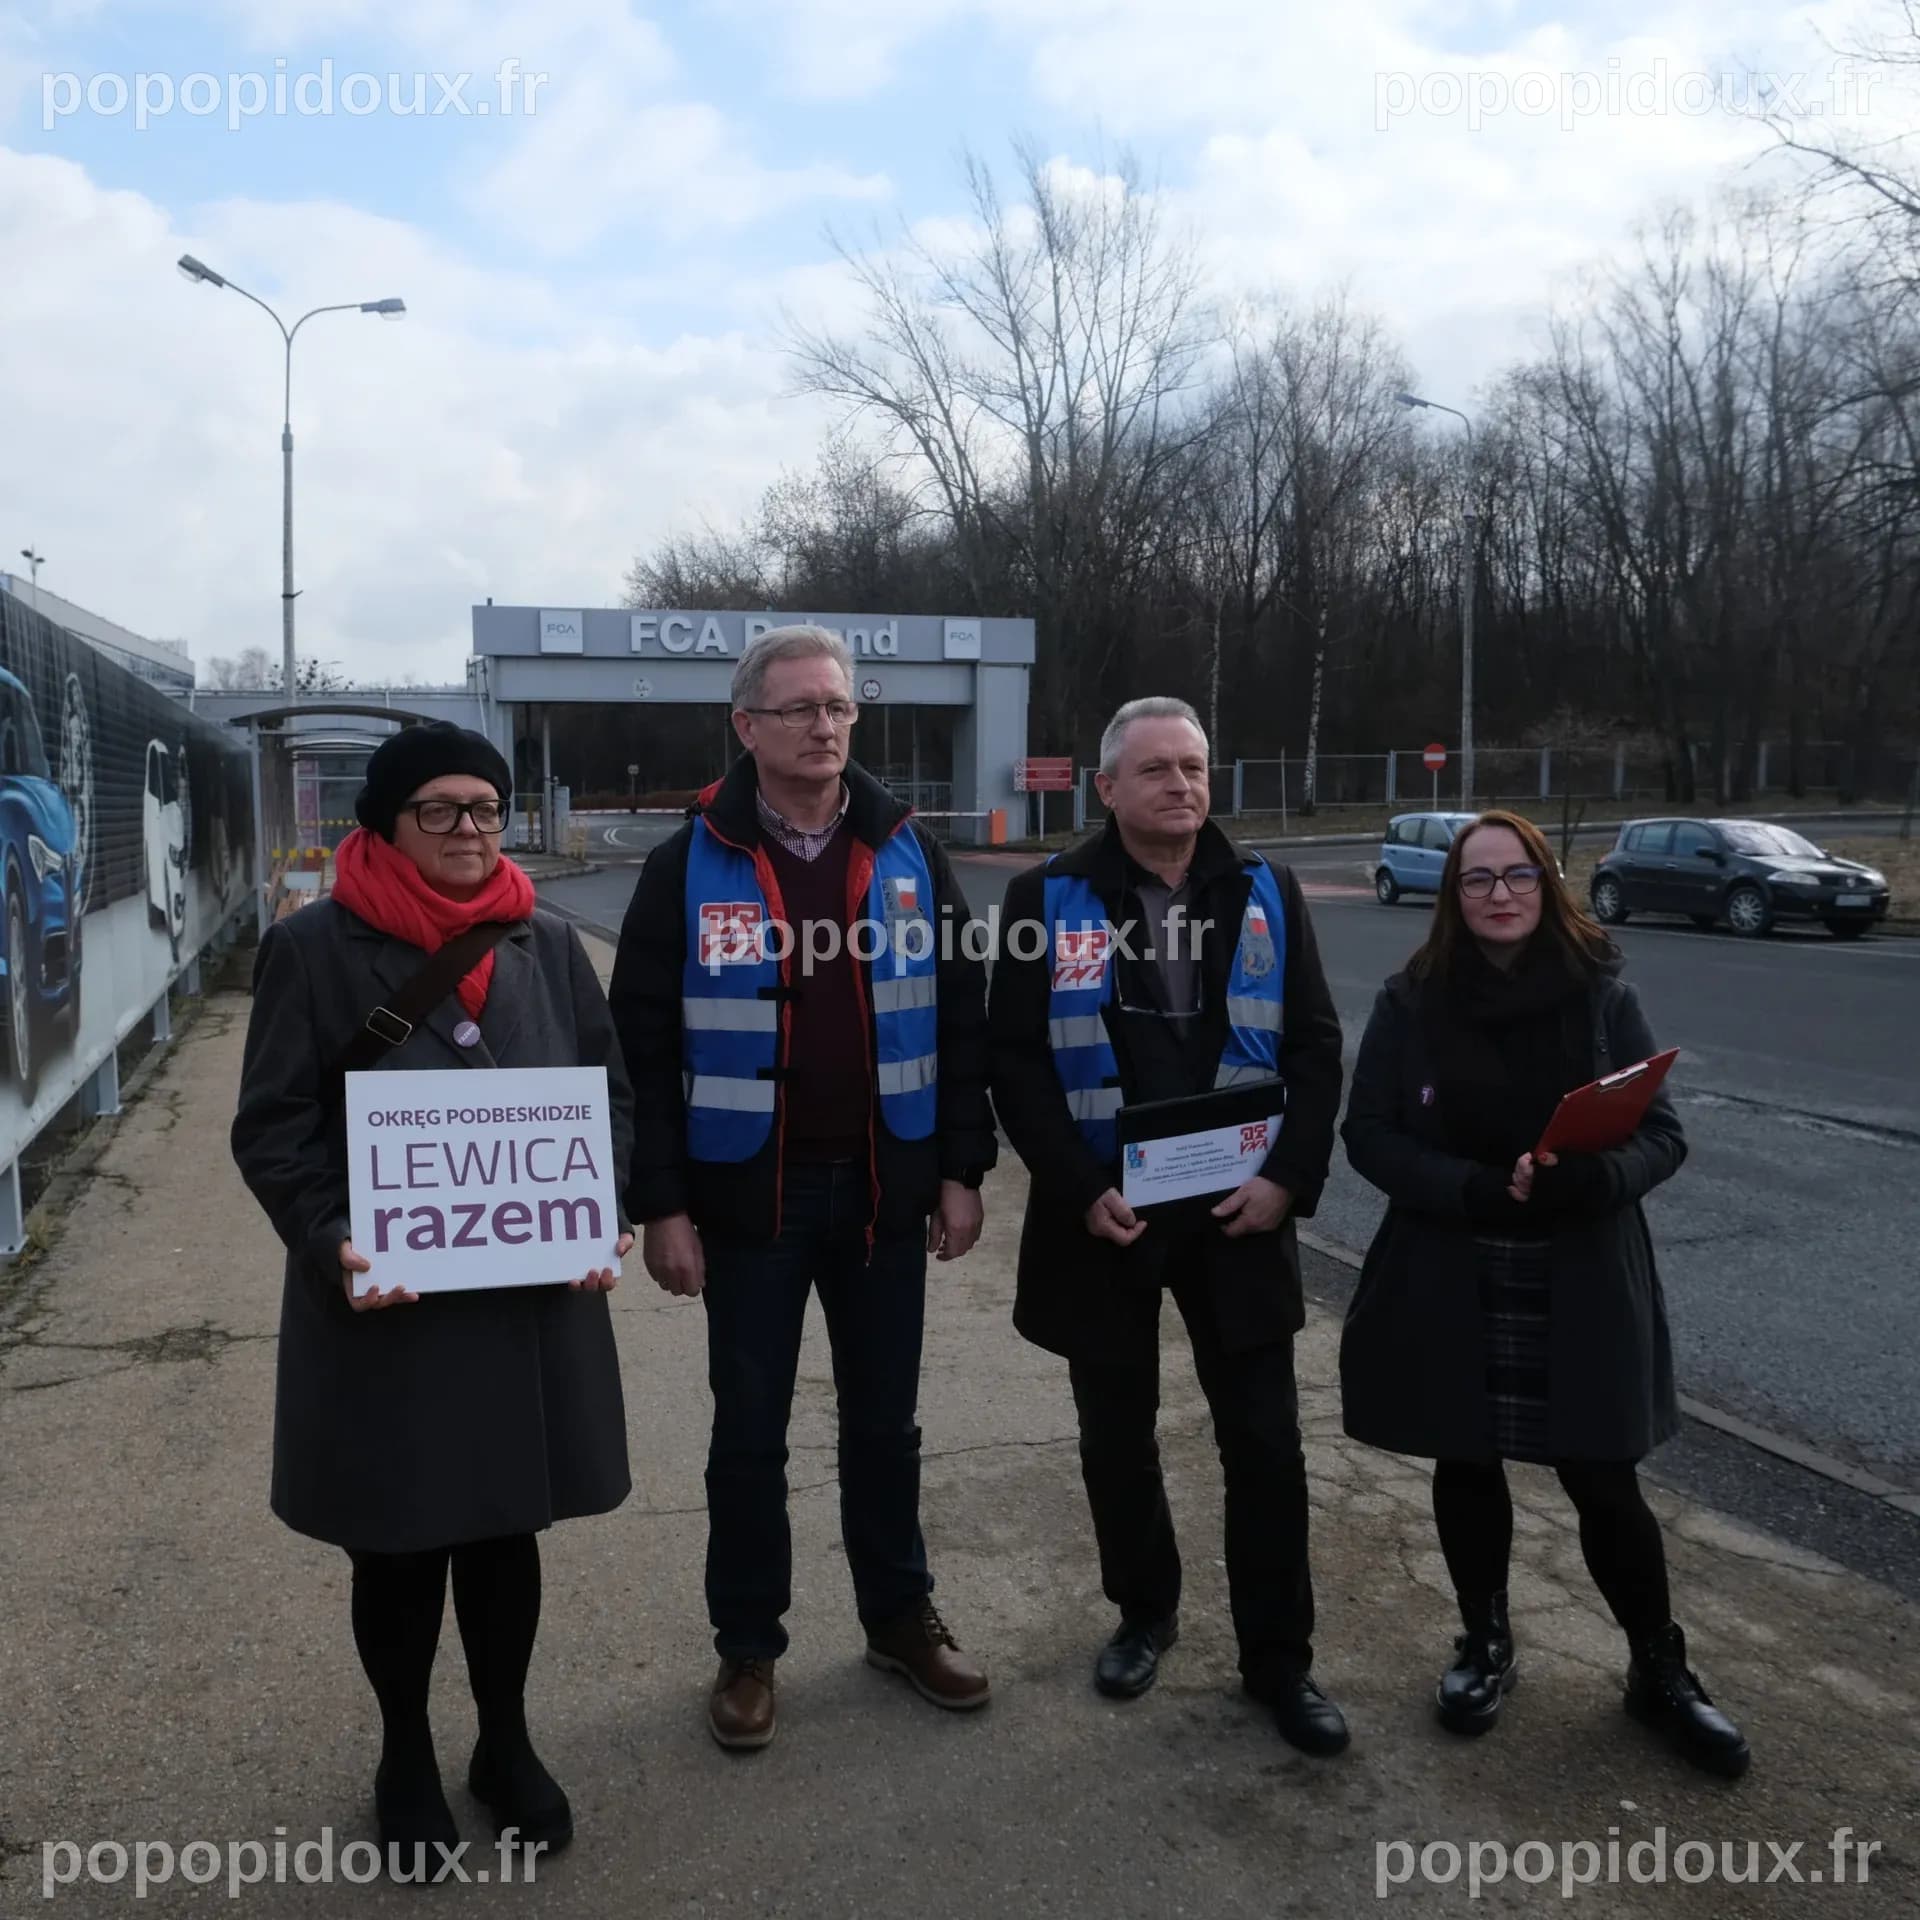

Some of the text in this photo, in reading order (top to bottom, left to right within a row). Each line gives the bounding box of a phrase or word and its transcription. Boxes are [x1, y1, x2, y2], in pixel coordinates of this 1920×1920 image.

[631, 615, 728, 653] FCA
[368, 1105, 592, 1129] OKRĘG PODBESKIDZIE
[370, 1137, 599, 1190] LEWICA
[374, 1197, 602, 1252] razem
